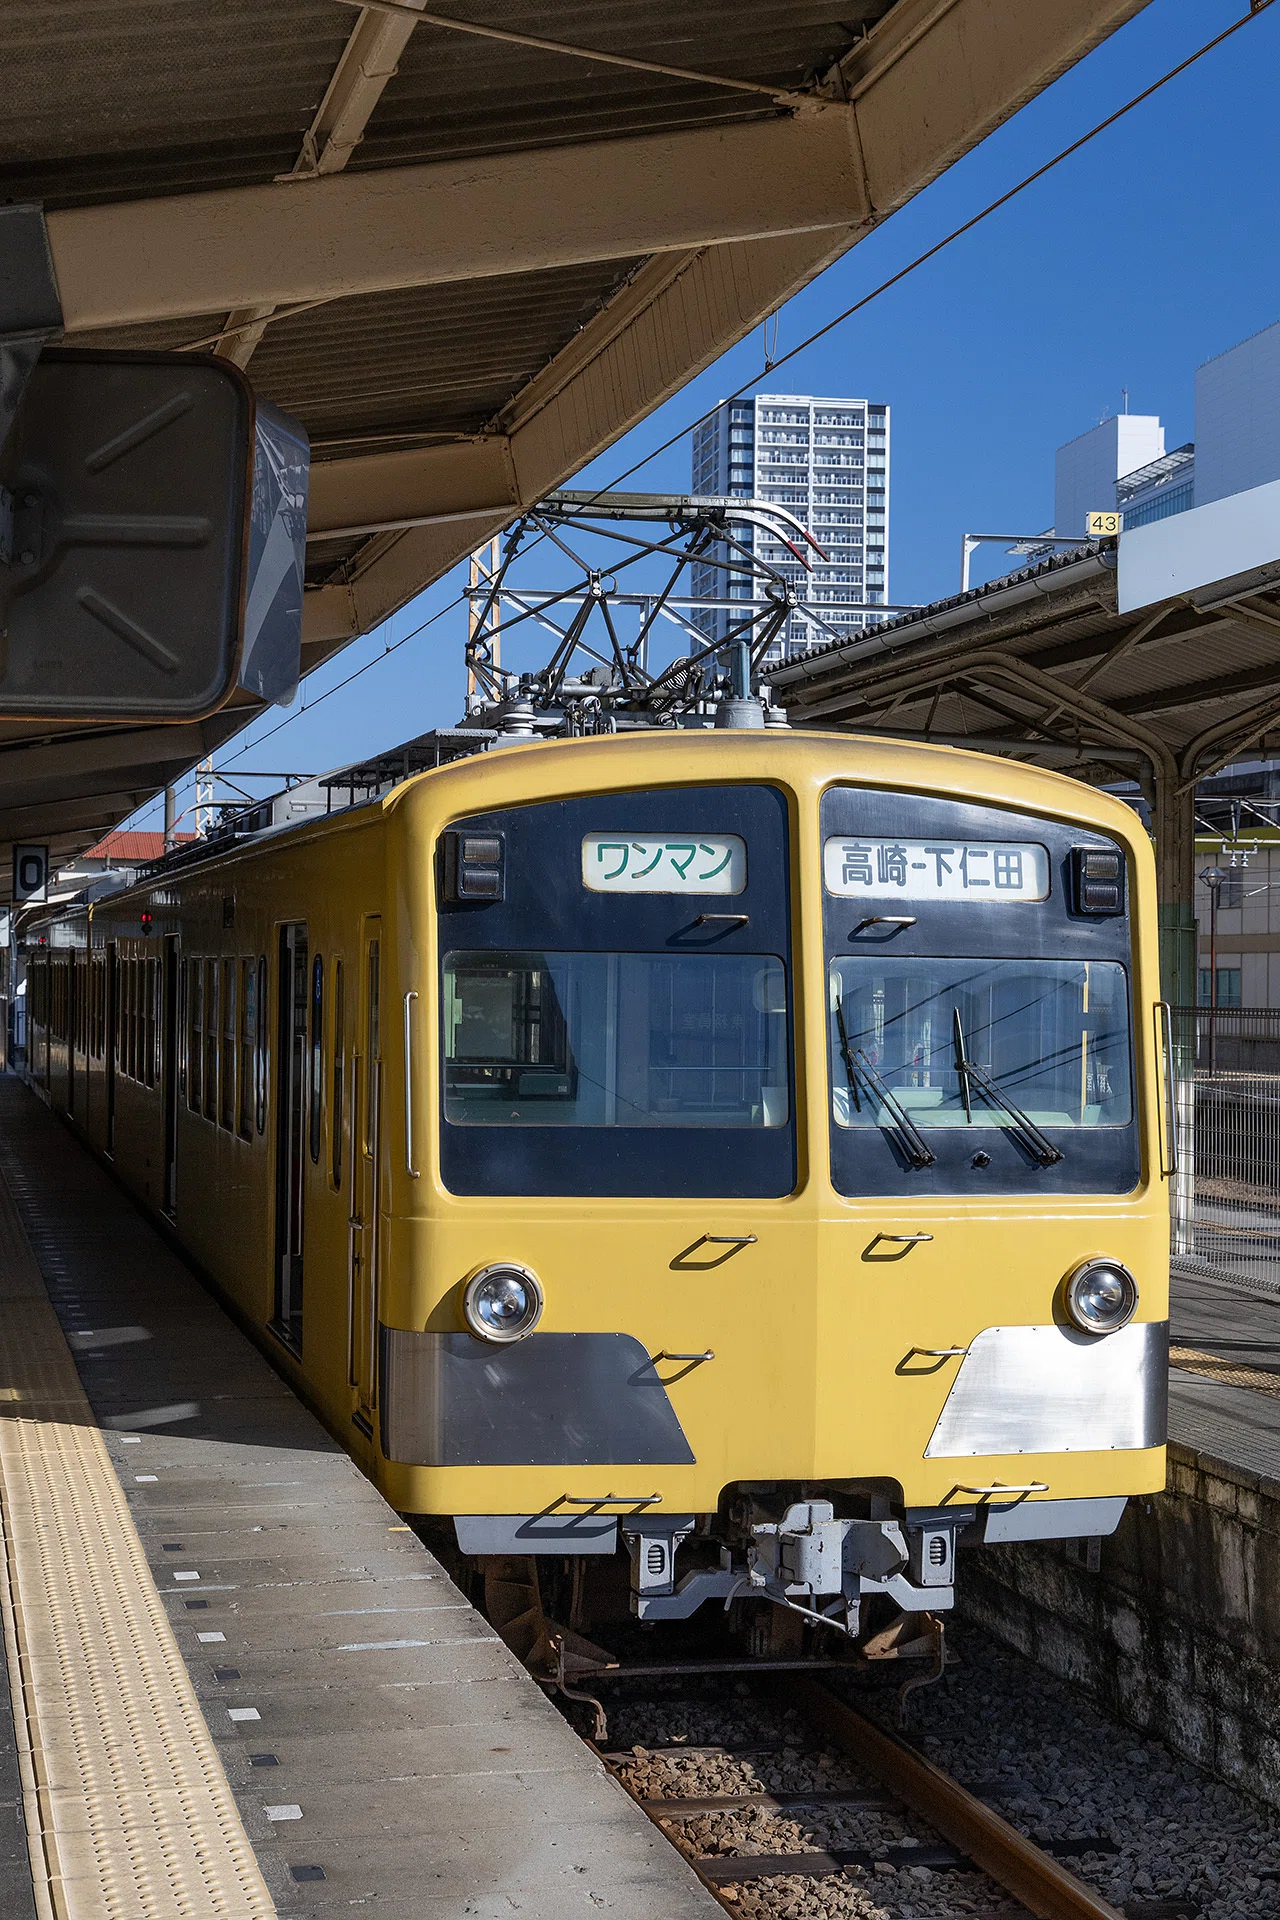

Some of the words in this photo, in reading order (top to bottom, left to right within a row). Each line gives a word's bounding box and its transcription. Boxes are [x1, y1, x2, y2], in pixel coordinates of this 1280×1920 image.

[1092, 516, 1116, 531] 43
[597, 842, 733, 880] ワンマン
